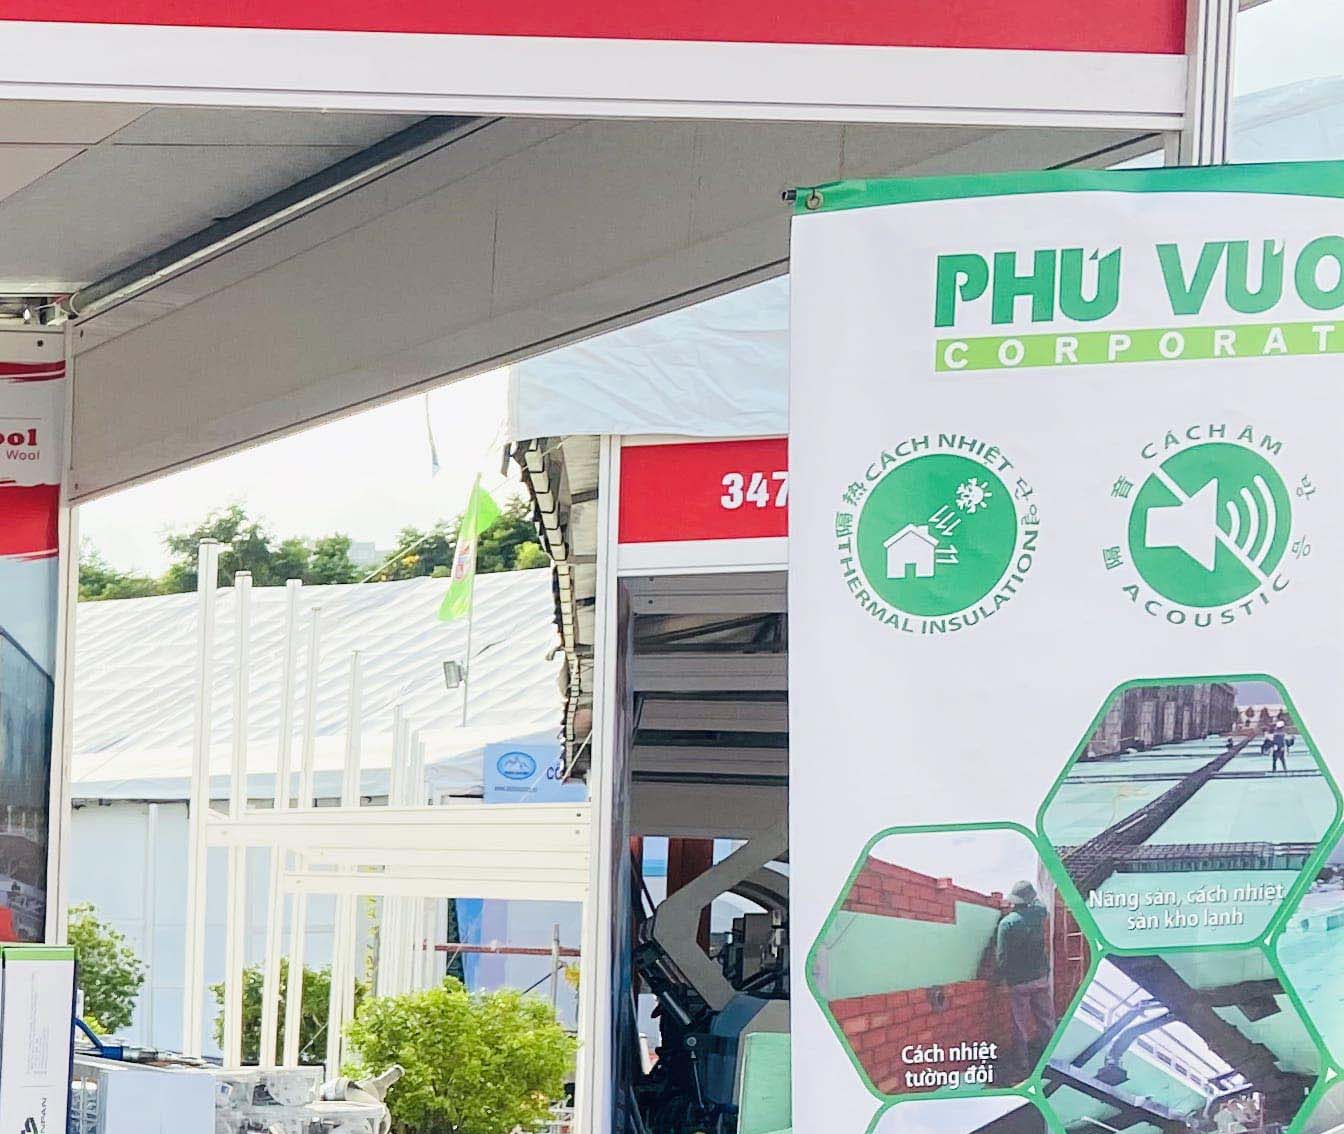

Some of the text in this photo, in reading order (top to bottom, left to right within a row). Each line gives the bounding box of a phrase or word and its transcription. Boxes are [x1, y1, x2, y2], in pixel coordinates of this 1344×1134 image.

[5, 450, 40, 462] Wool
[721, 471, 789, 510] 347
[838, 530, 1040, 634] THERMAL INSULATION
[1123, 574, 1290, 628] ACOUSTIC
[1164, 907, 1198, 928] kho
[901, 1041, 997, 1064] Cách nhiệt
[905, 1067, 960, 1090] tường
